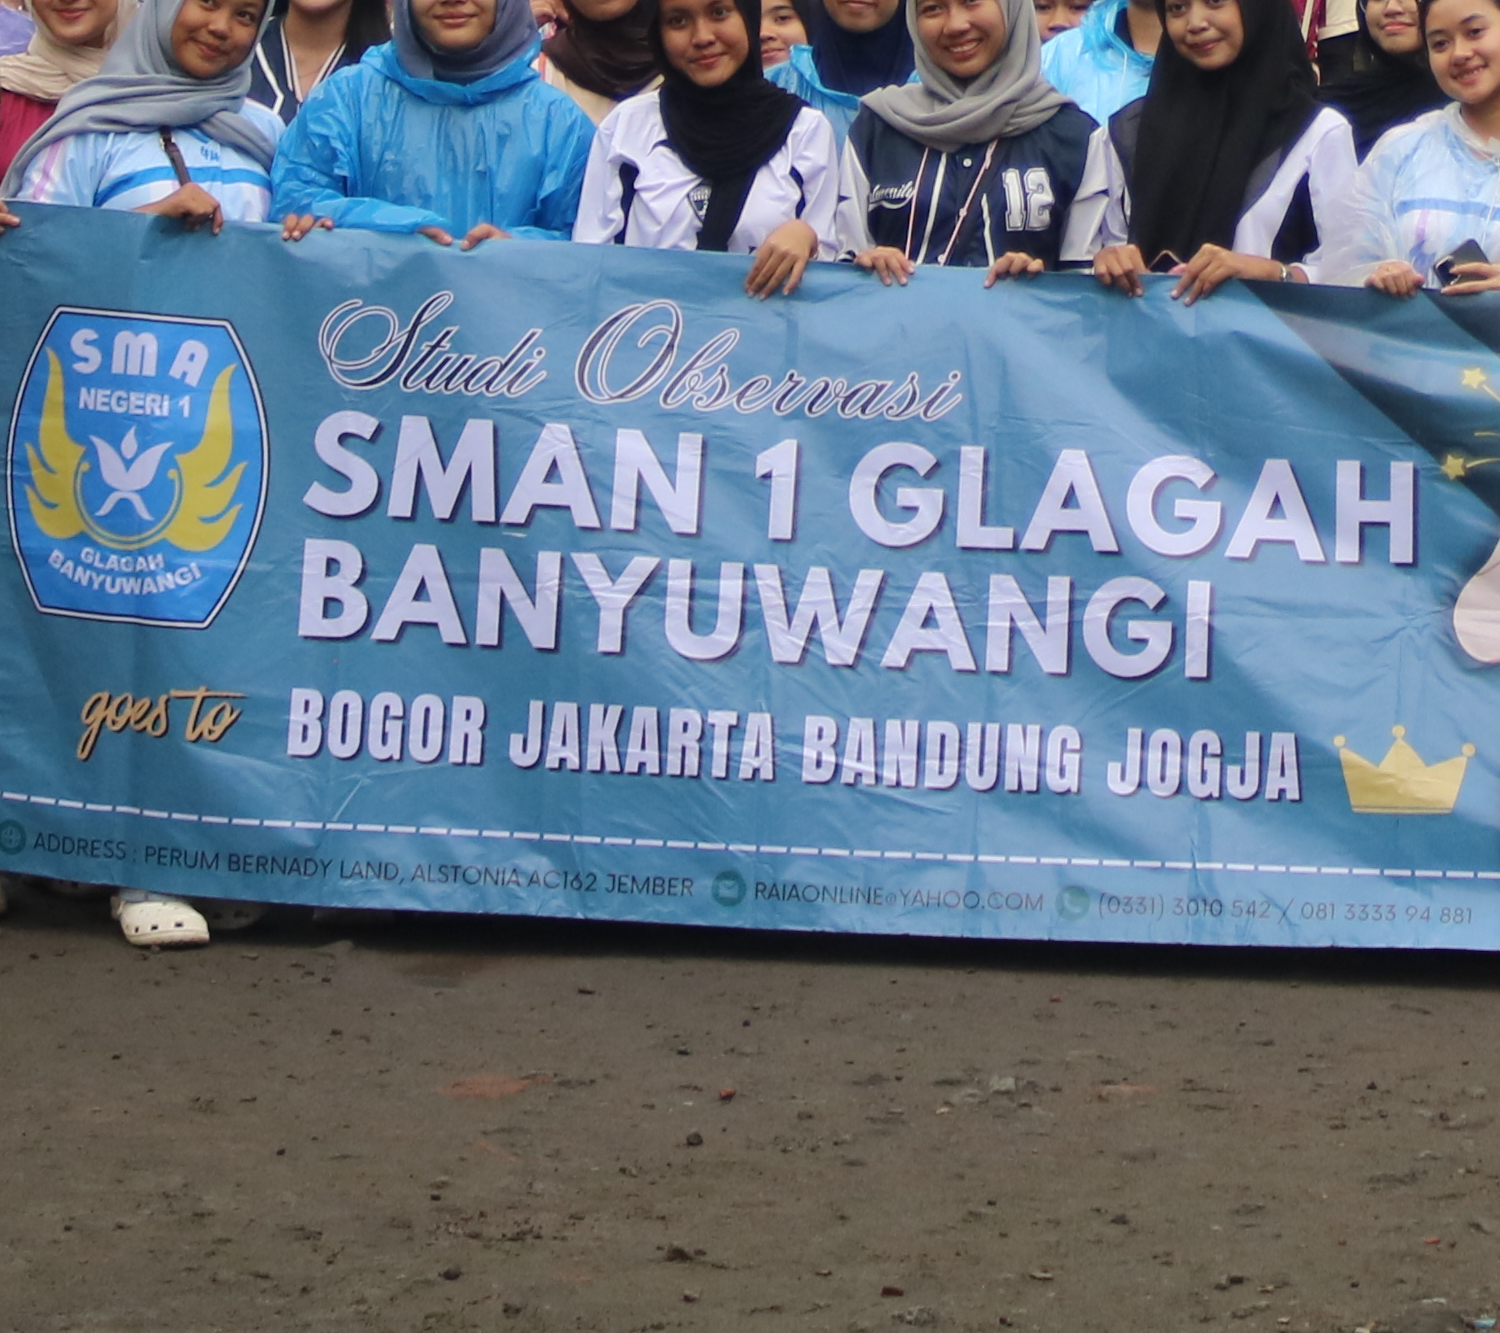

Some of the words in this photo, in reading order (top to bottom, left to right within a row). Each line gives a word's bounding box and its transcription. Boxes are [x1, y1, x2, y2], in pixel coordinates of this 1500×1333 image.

[1002, 167, 1055, 231] 12
[317, 289, 550, 397] Studi
[575, 297, 963, 422] Observasi
[78, 386, 171, 418] NEGERI
[177, 394, 192, 419] 1
[301, 409, 704, 536] SMAN
[754, 437, 799, 542] 1
[847, 439, 1418, 566] GLAGAH
[46, 547, 203, 597] BANYUWANGI
[79, 546, 165, 573] GLAGAH
[297, 538, 1213, 682] BANYUWANGI
[76, 689, 170, 761] goes
[169, 684, 248, 743] to
[286, 686, 488, 766] BOGOR
[508, 698, 777, 783] JAKARTA
[801, 714, 1083, 796] BANDUNG
[1105, 726, 1303, 802] JOGJA
[32, 831, 128, 863] ADDRESS
[143, 846, 221, 872] PERUM
[226, 852, 332, 879] BERNADY
[339, 858, 407, 884] LAND,
[410, 861, 523, 889] ALSTONIA
[526, 869, 599, 893] AC162
[604, 872, 695, 898] JEMBER
[754, 880, 1045, 913] RAIAONLINE@YAHOO.COM
[1098, 890, 1165, 920] (0331)
[1171, 893, 1224, 919] 3010
[1230, 895, 1273, 920] 542
[1300, 898, 1337, 921] 081
[1344, 899, 1398, 923] 3333
[1405, 902, 1432, 925] 94
[1439, 904, 1475, 926] 881
